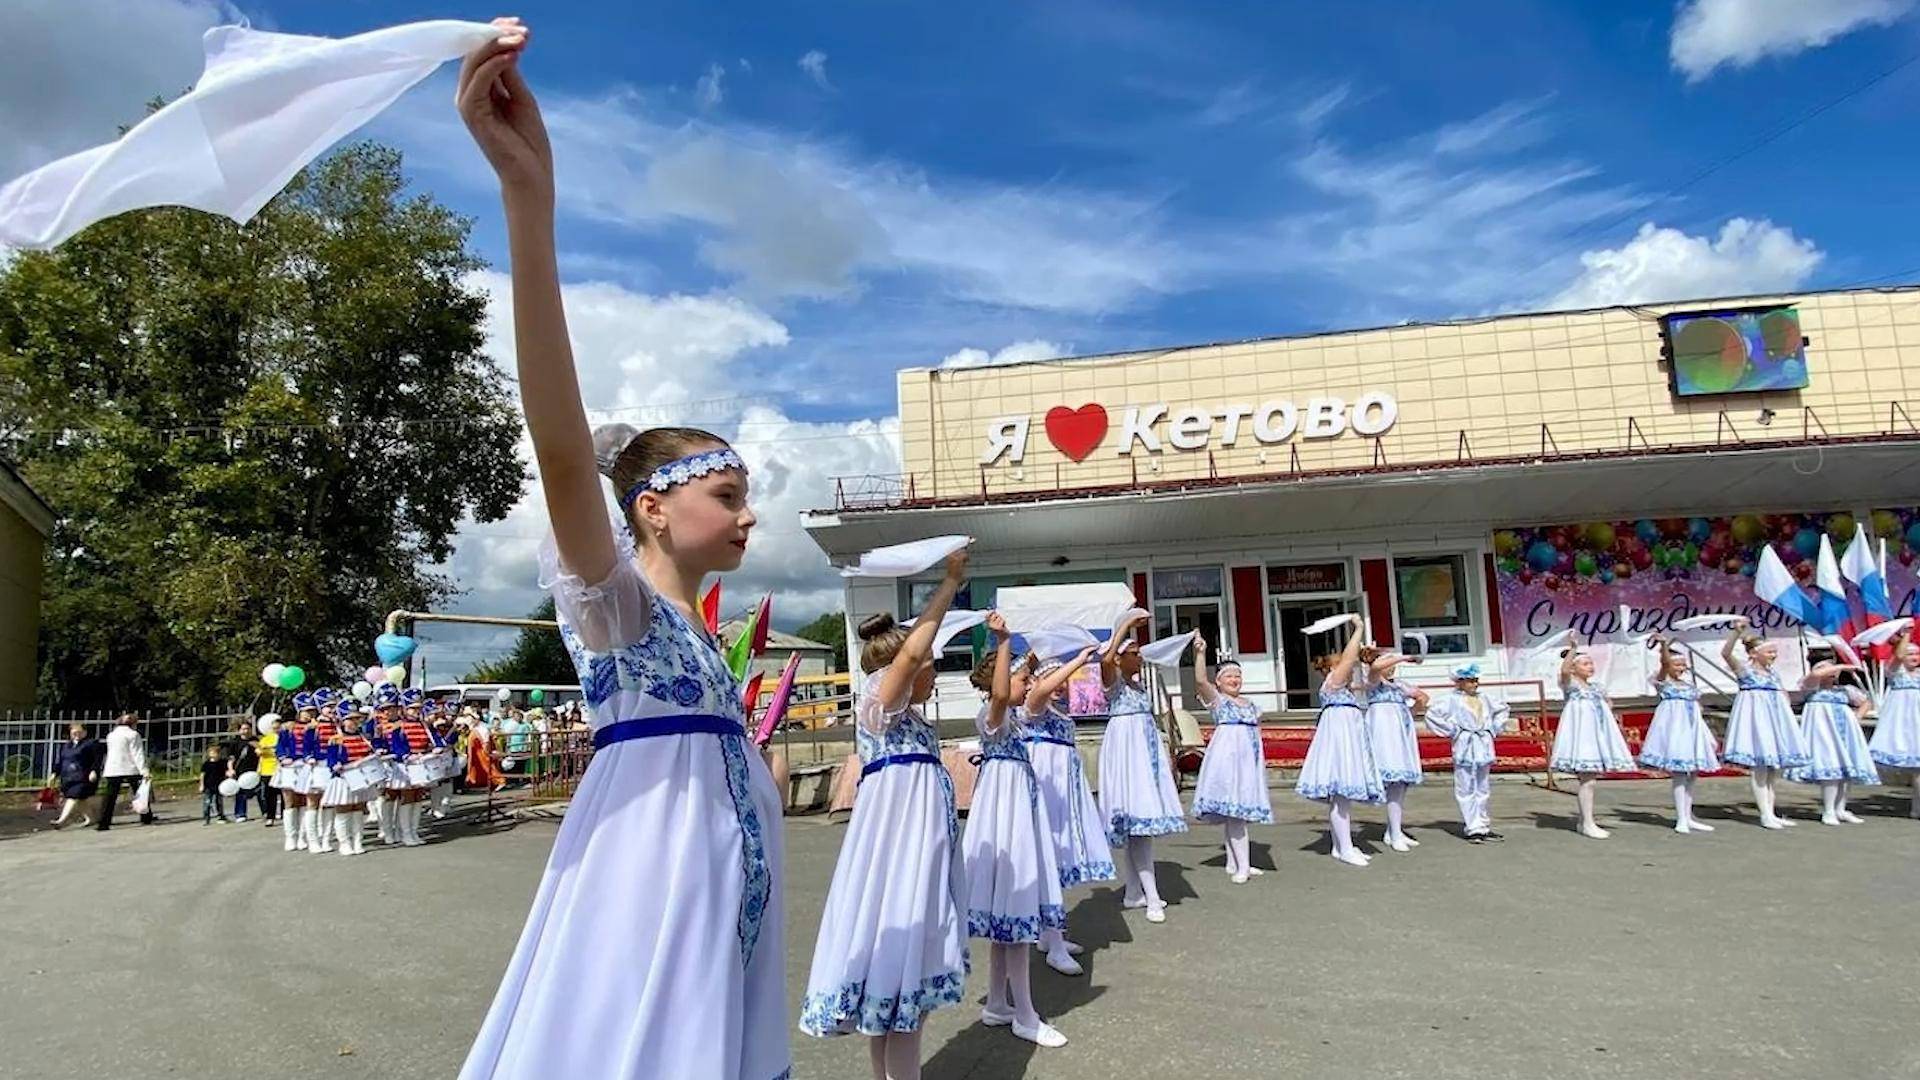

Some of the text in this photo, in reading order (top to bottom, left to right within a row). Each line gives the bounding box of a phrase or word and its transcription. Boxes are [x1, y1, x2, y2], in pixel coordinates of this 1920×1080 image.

[979, 391, 1399, 466] Я Кетово
[1527, 599, 1555, 637] С
